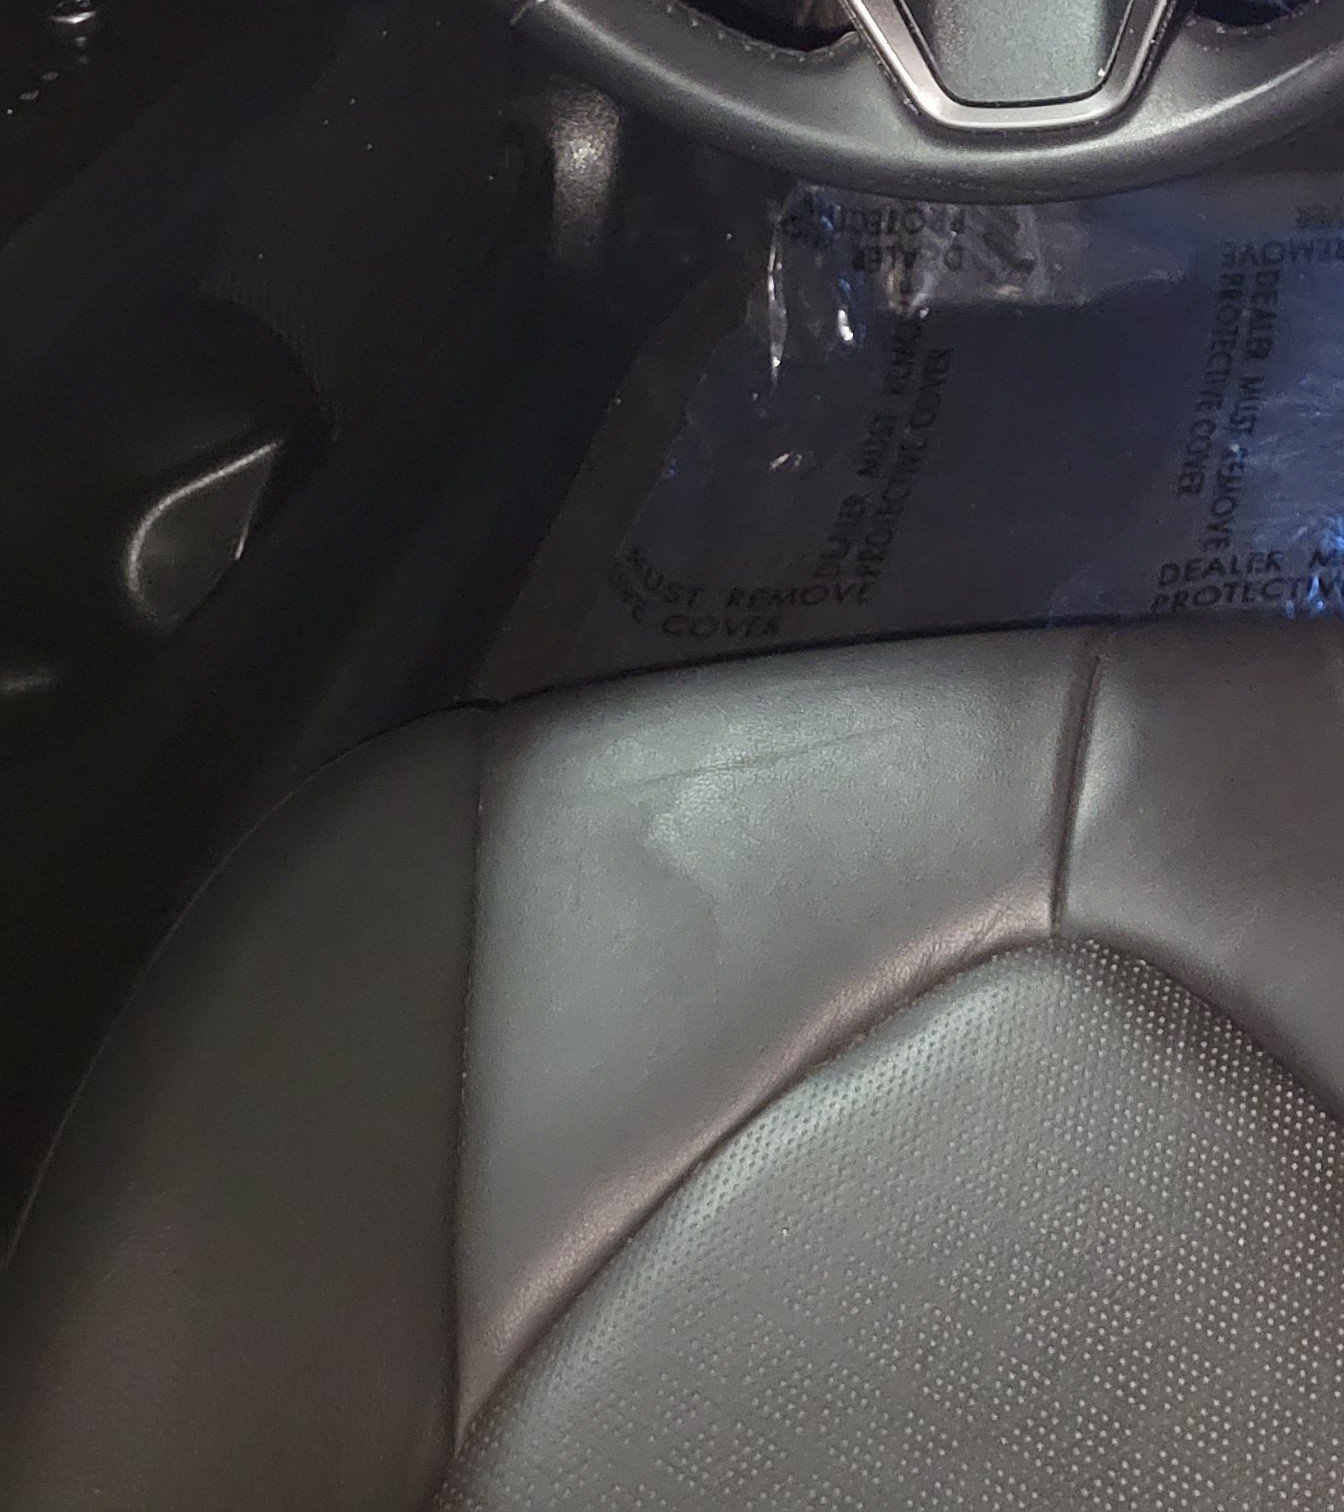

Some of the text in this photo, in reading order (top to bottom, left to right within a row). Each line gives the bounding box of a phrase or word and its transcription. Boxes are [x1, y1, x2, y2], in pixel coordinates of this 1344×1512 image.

[1176, 272, 1245, 499] PROTECTIVE COVER
[1229, 376, 1264, 435] MUST
[1157, 550, 1286, 589] DEALER
[661, 612, 783, 639] COVER
